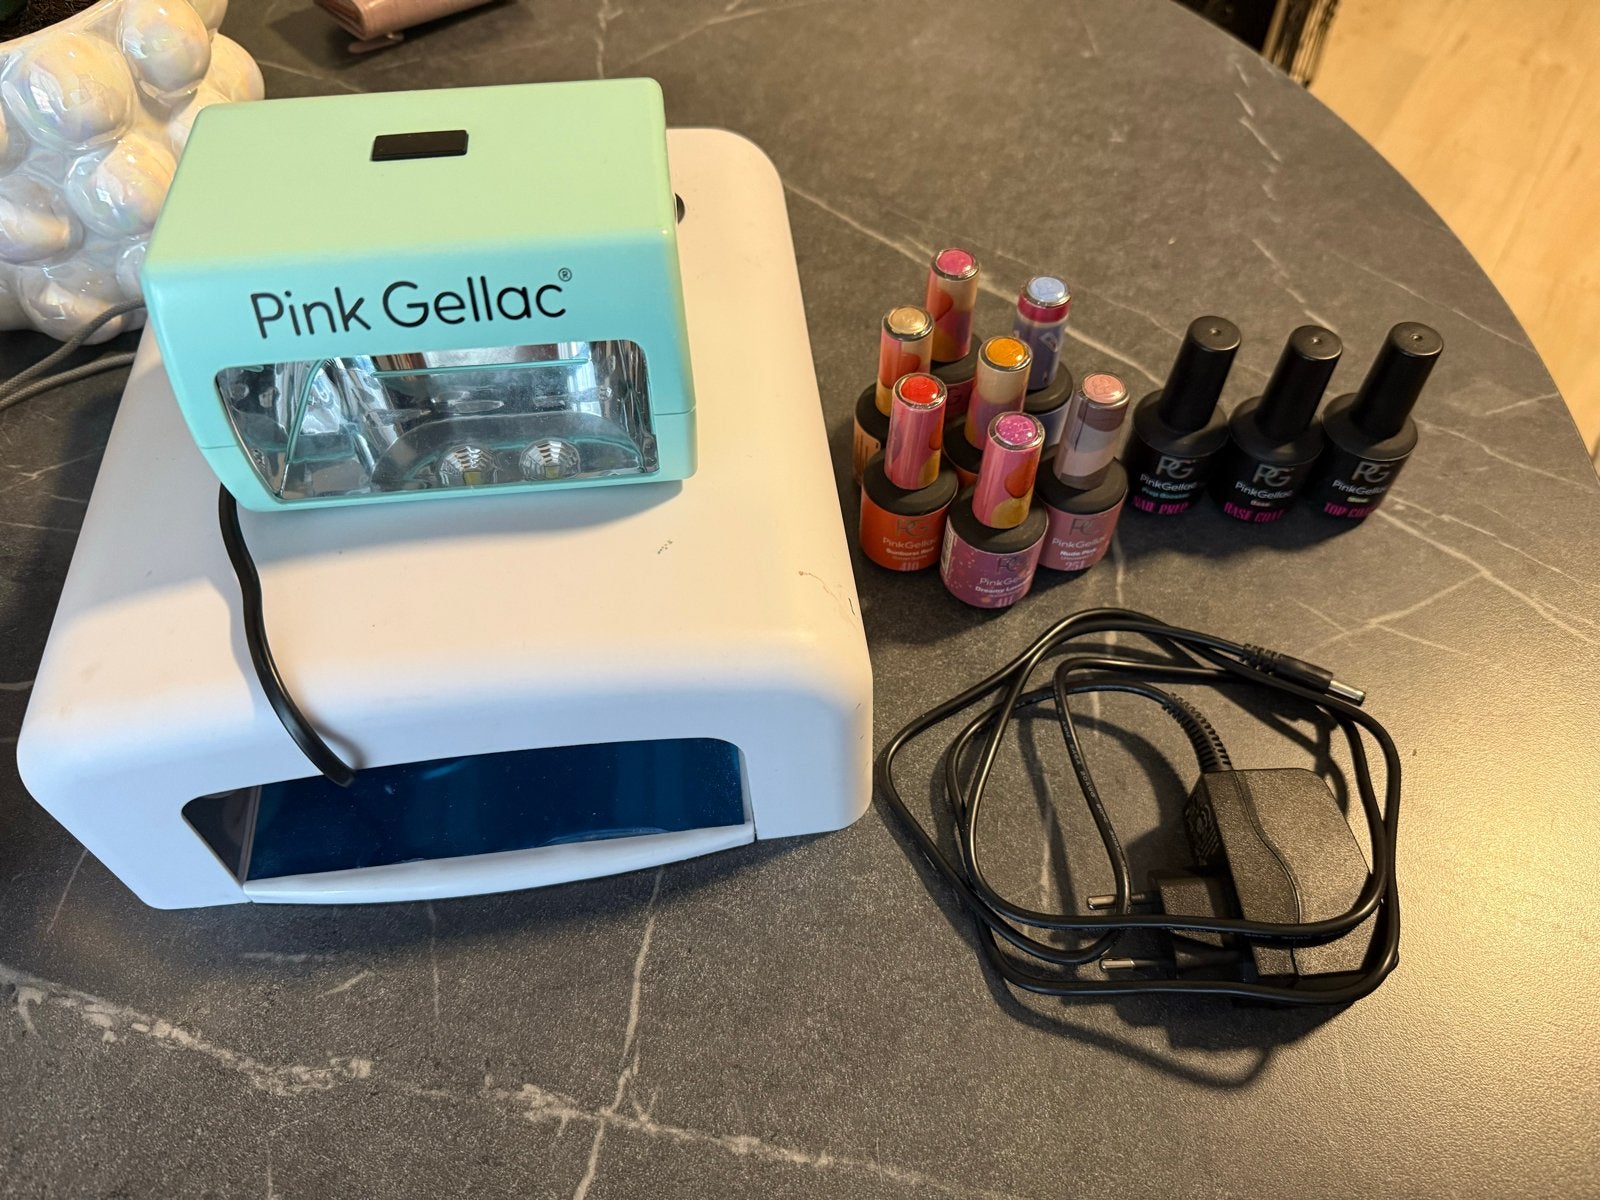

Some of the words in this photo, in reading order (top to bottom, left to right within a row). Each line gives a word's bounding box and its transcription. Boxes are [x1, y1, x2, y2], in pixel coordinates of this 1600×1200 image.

[250, 287, 372, 340] Pink
[1224, 502, 1252, 520] BASE
[1324, 502, 1348, 516] TOP
